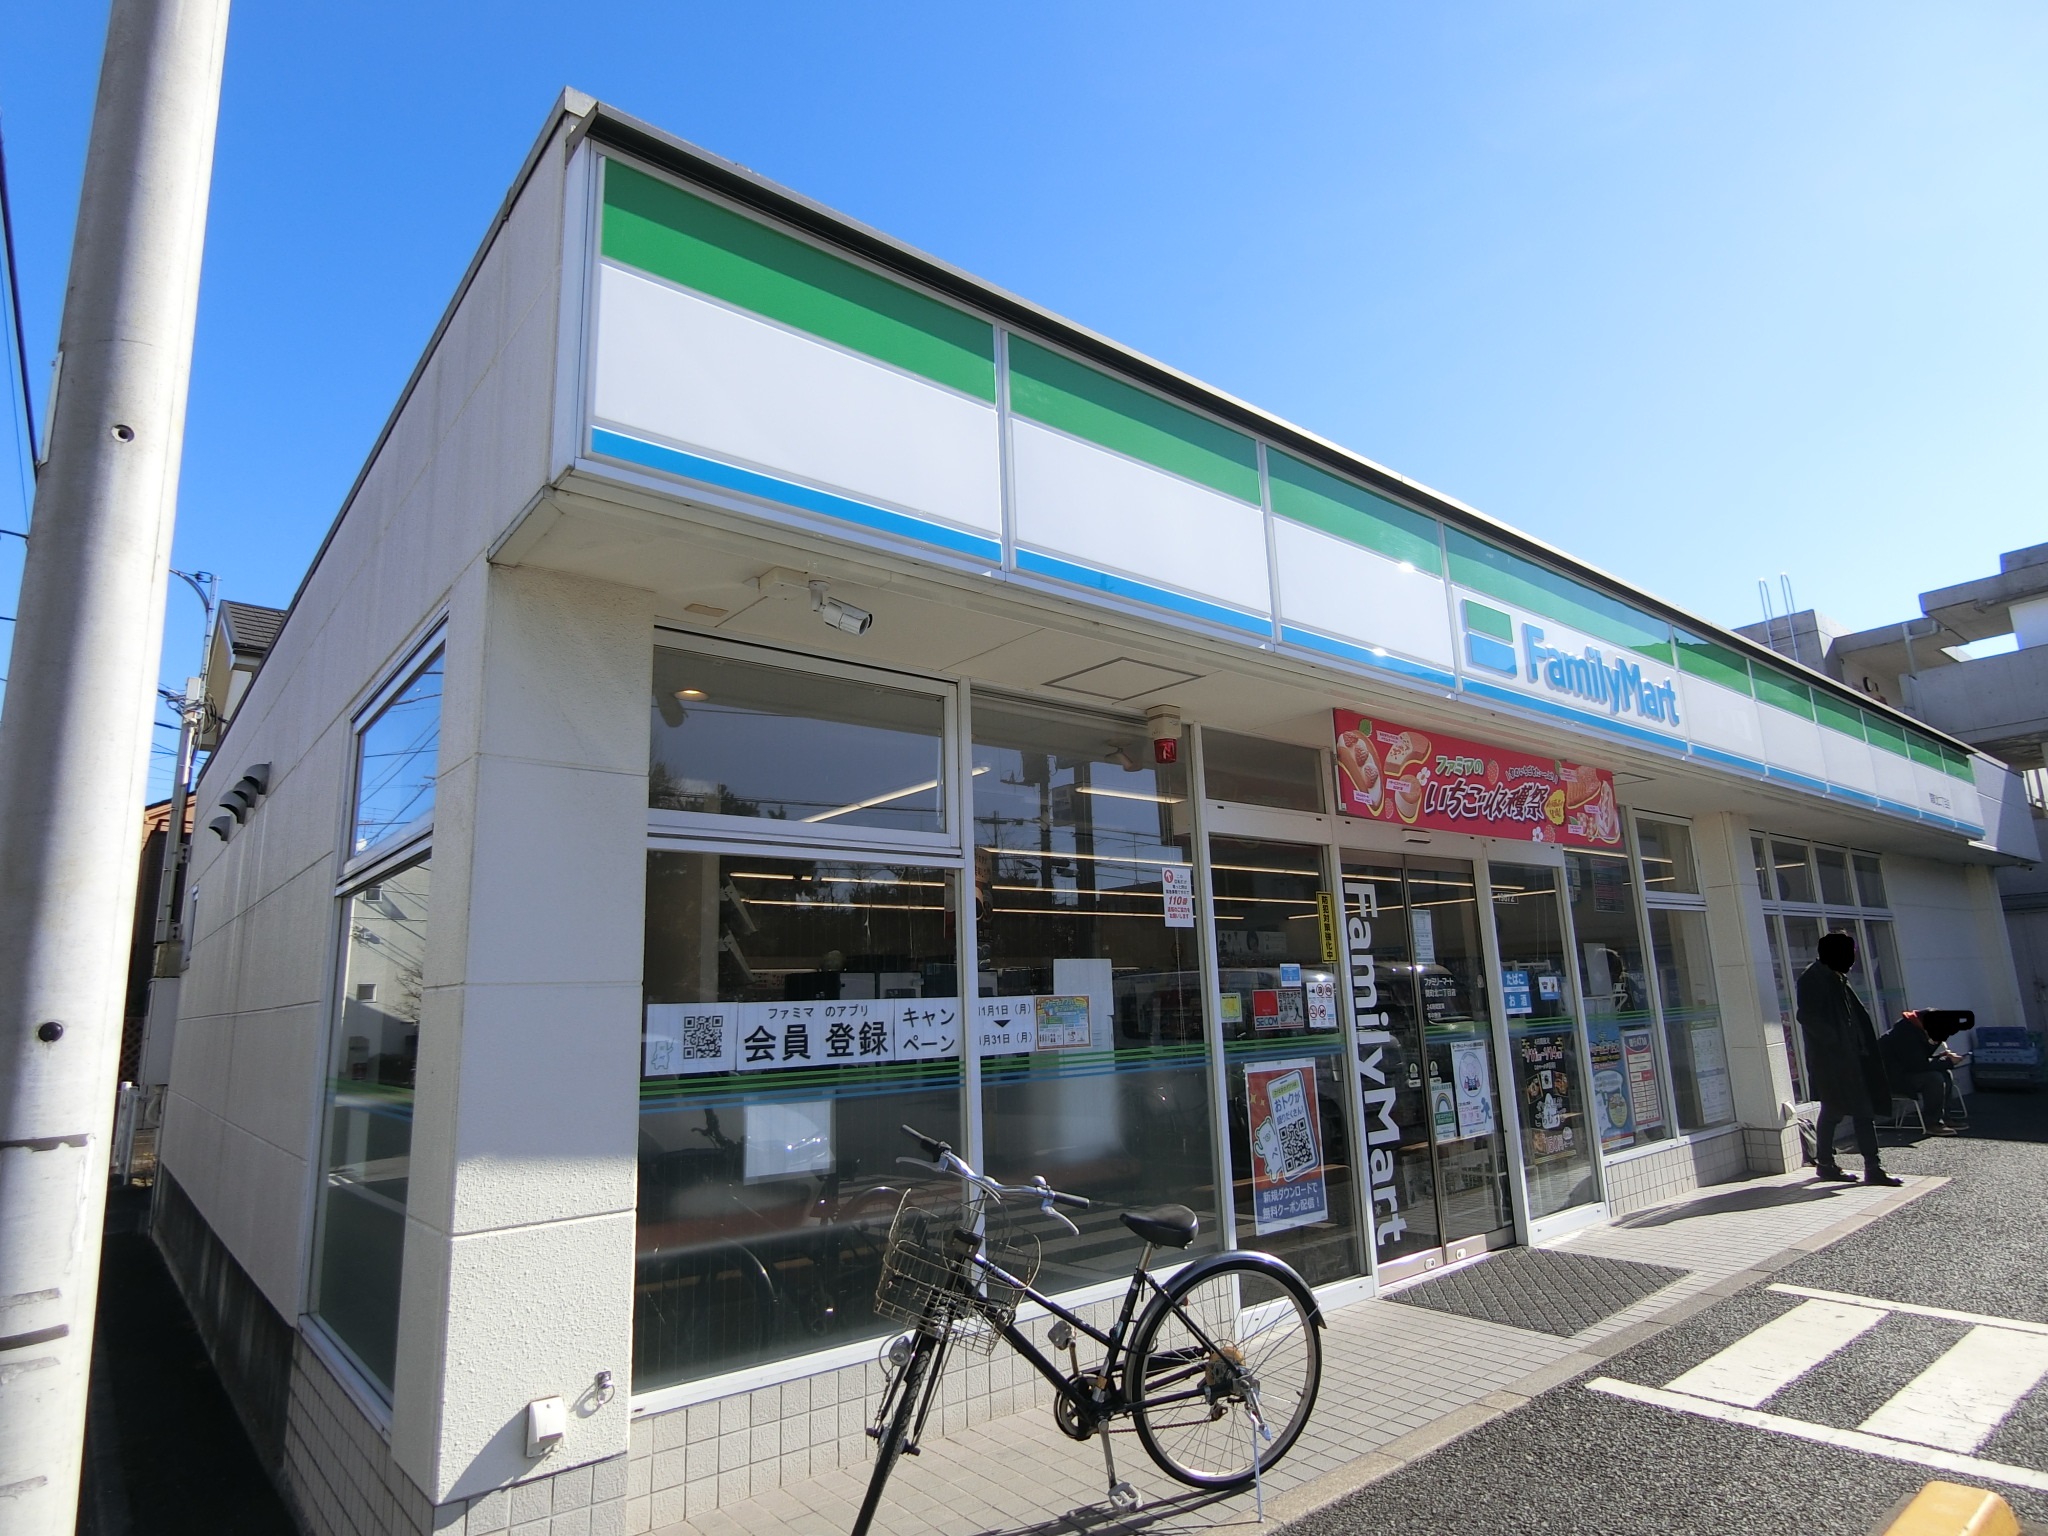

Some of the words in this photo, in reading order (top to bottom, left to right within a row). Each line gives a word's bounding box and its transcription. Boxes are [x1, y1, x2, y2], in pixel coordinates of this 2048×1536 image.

[1523, 622, 1679, 727] FamilyMart
[1436, 756, 1484, 776] ファミマの
[1424, 778, 1550, 823] いちご収穫祭
[1169, 896, 1188, 905] 110番
[1321, 896, 1333, 959] 防犯対策強化中
[1424, 977, 1454, 986] ファミリーマート
[1506, 973, 1524, 985] たばこ
[768, 1007, 814, 1019] ファミマ
[825, 1004, 868, 1017] のアプリ
[903, 1007, 955, 1028] キャン
[1256, 1017, 1278, 1026] SECOM
[744, 1024, 811, 1062] 会員
[825, 1021, 888, 1057] 登録
[903, 1034, 955, 1052] ペーン
[1344, 882, 1408, 1245] FamilyMart
[1274, 1090, 1301, 1112] おトクが
[1263, 1182, 1318, 1204] 新規ダウンロードで
